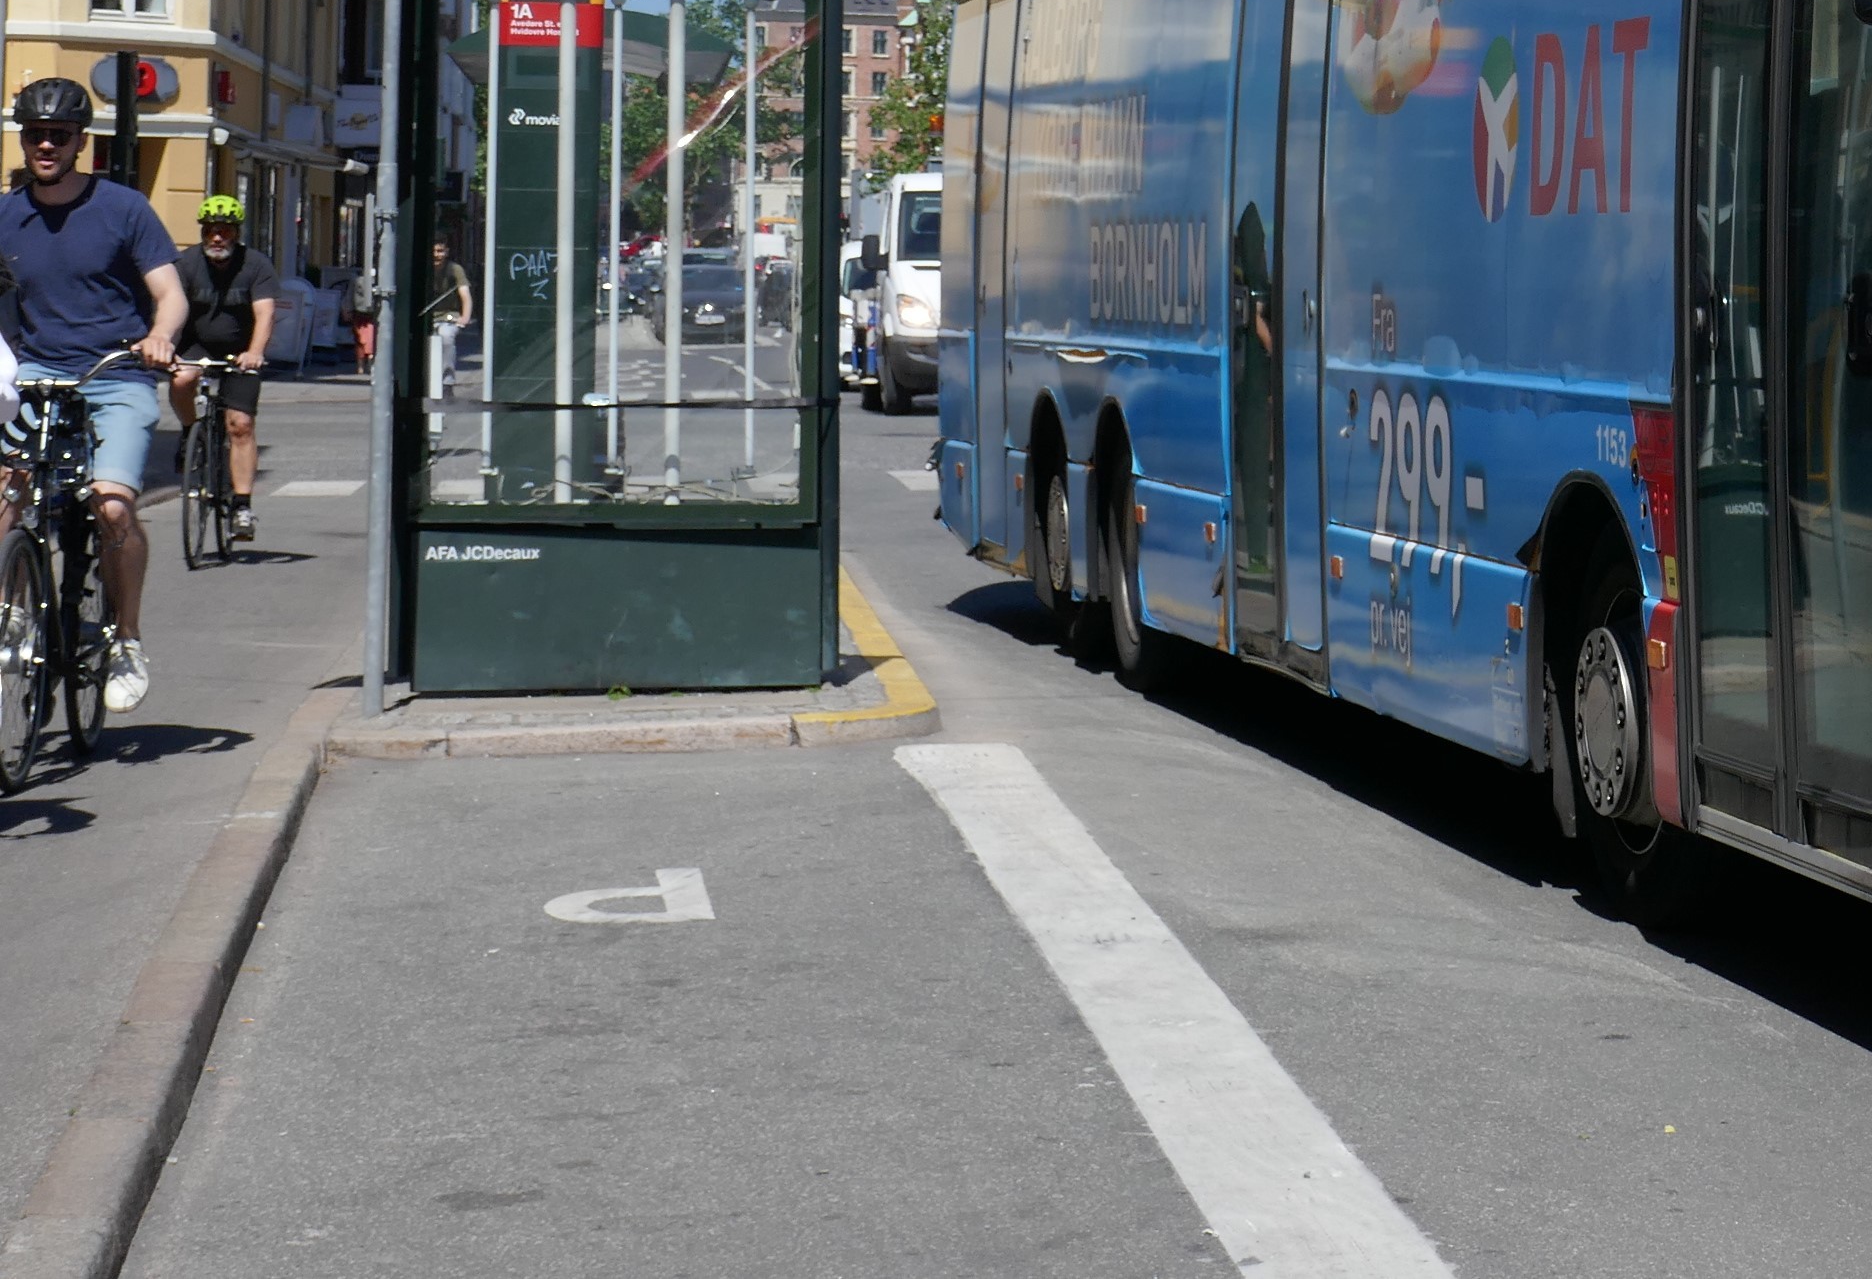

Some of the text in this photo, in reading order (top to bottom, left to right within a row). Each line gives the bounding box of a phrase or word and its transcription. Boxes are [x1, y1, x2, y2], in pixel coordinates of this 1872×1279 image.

[510, 3, 533, 19] 1A
[1530, 15, 1651, 216] DAT
[1090, 221, 1206, 325] BORNHOLM
[1371, 293, 1395, 353] Fra
[1594, 423, 1627, 469] 1153
[424, 545, 540, 561] AFA JCDecaux
